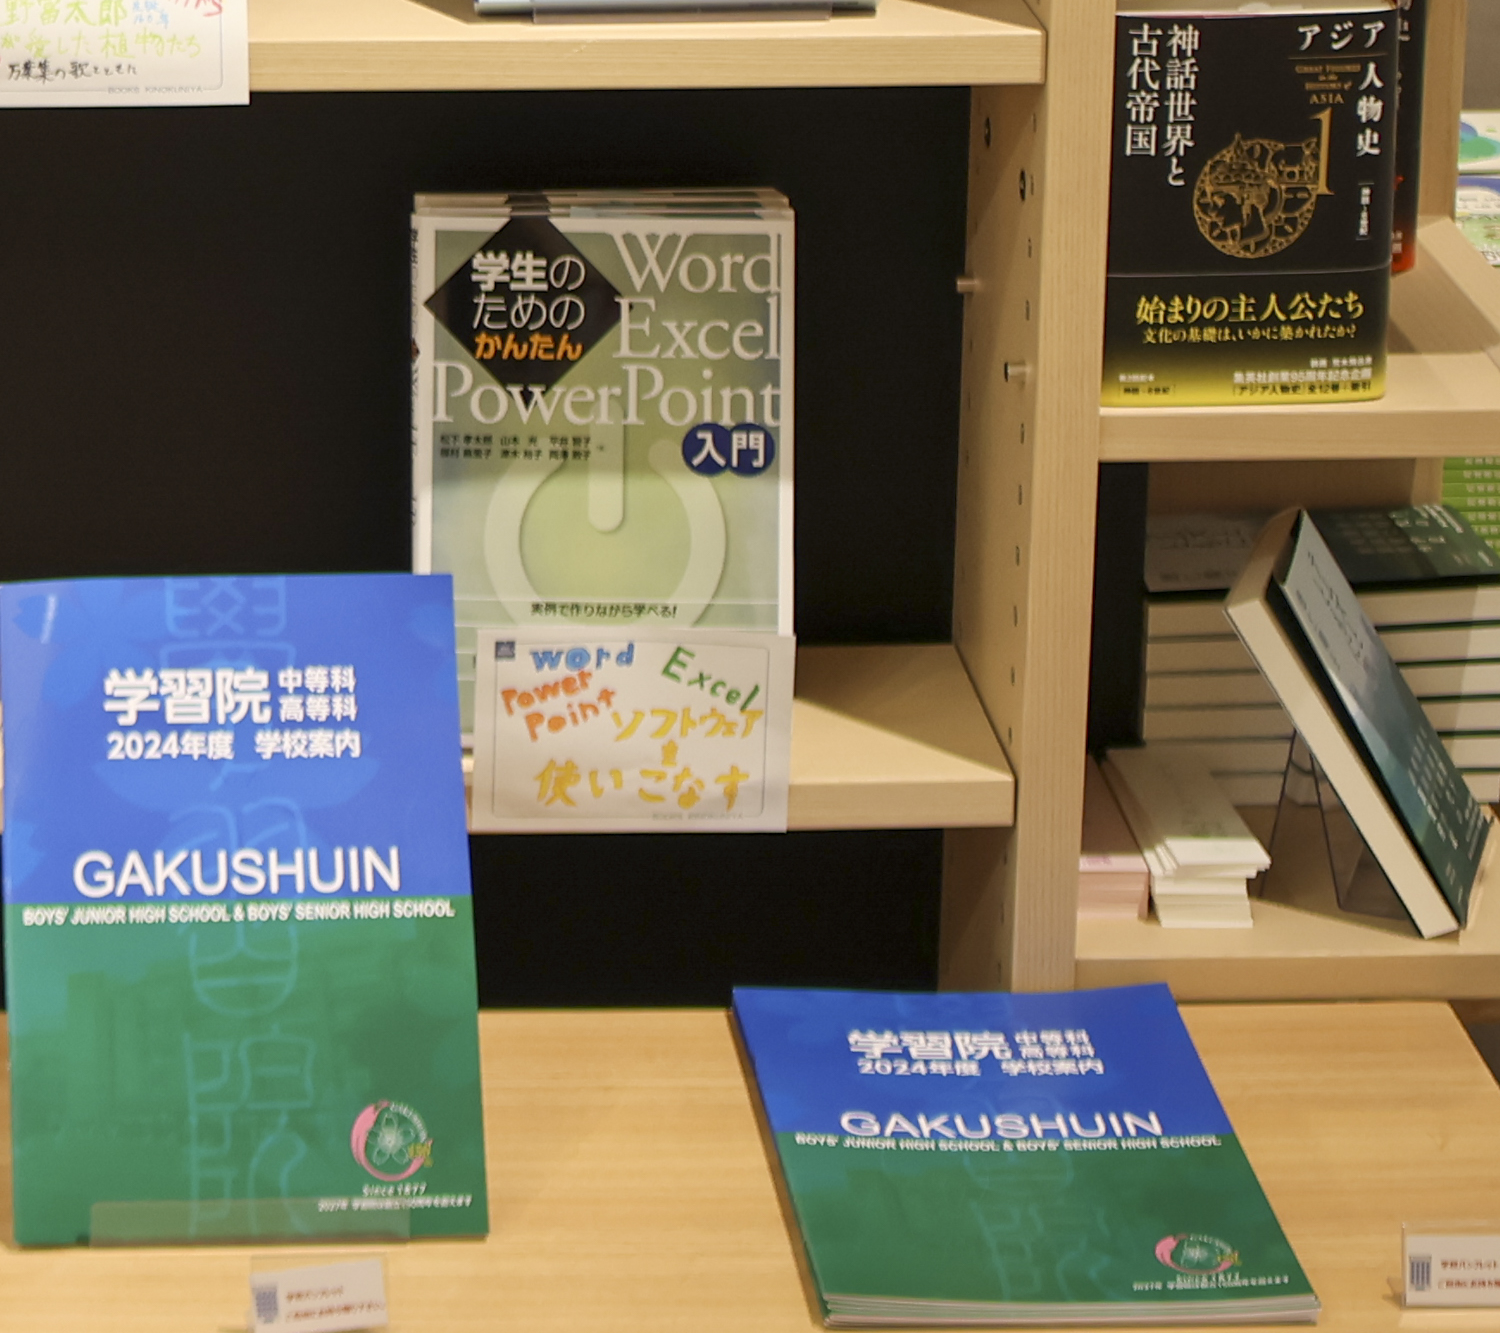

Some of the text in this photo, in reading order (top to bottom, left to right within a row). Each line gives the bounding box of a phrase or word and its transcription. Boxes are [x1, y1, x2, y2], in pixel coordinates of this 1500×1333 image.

[1296, 20, 1386, 51] アジア
[1124, 22, 1164, 157] 古代帝国
[1162, 23, 1200, 188] 神話世界と
[1309, 93, 1345, 105] ASIA
[1355, 60, 1385, 158] 人物史
[1308, 106, 1335, 196] 1
[471, 251, 586, 292] 学生の
[604, 231, 780, 294] Word
[472, 292, 586, 331] ための
[612, 295, 780, 360] Excel
[1136, 290, 1365, 326] 始まりの主人公たち
[473, 331, 583, 362] かんたん
[432, 360, 781, 427] PowerPoint
[691, 430, 766, 469] 入門
[102, 667, 272, 727] 学習院
[278, 666, 358, 694] 中等科
[661, 646, 760, 712] Excel
[278, 694, 358, 724] 高等科
[106, 729, 362, 761] 2024年度 学校案内
[534, 758, 750, 813] 使いこなす
[73, 846, 401, 898] GAKUSHUIN
[71, 906, 127, 925] JUNIOR
[129, 906, 167, 924] HIGH
[168, 905, 231, 924] SCHOOL
[233, 904, 246, 922] &
[294, 902, 352, 921] SENIOR
[353, 900, 390, 919] HIGH
[392, 899, 456, 919] SCHOOL
[847, 1028, 1013, 1061] 学習院
[857, 1058, 1105, 1077] 2024年度 学校案内
[839, 1110, 1165, 1140] GAKUSHUIN
